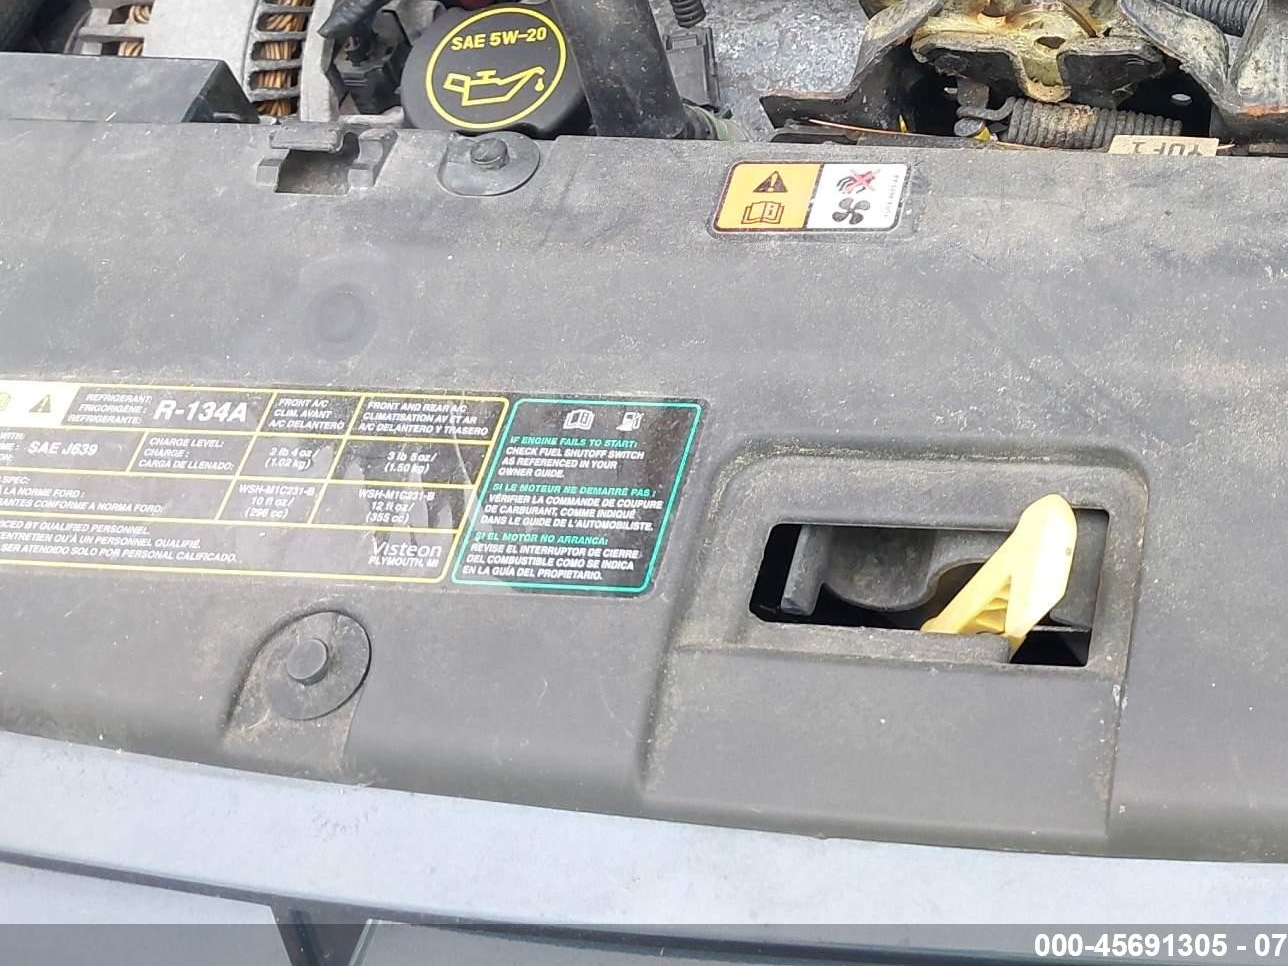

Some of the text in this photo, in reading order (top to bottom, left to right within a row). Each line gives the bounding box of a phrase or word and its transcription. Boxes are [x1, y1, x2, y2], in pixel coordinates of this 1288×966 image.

[451, 27, 548, 50] SAE 5W-20
[86, 393, 153, 404] REFRIGERANT:
[278, 398, 328, 408] FRONT A/C
[78, 402, 143, 413] FRIGORIGÈNE
[153, 400, 248, 422] R-134A
[274, 408, 332, 418] CLIM. AVANT
[368, 402, 468, 412] FRONT AND REAR A/C
[68, 414, 142, 424] REFRIGERANTE:
[362, 412, 478, 424] CLIMATISATION AV ET AR
[268, 419, 344, 430] A/C DELANTERO
[358, 422, 488, 435] A/C DELANTERO Y TRASERO
[149, 438, 224, 448] CHARGE LEVEL:
[510, 436, 638, 448] IF ENGINE FAILS TO START:
[28, 441, 61, 454] SAE
[62, 442, 98, 456] J639
[144, 448, 185, 458] CHARGE
[506, 447, 645, 460] CHECK FUEL SHUTOFF SWITCH
[387, 452, 438, 462] 3 lb 5 oz/
[138, 459, 234, 470] CARGA DE LLENADO:
[264, 458, 311, 470] (1.02 kg)
[384, 462, 430, 474] (1.50 kg)
[502, 458, 618, 469] AS REFERENCED IN YOUR
[498, 468, 565, 478] OWNER GUIDE.
[2, 476, 31, 484] SPEC:
[3, 486, 80, 498] LA NORME FORD
[358, 488, 436, 501] WSH-M1C231-B
[492, 483, 503, 491] SI
[505, 484, 518, 492] LE
[519, 484, 561, 493] MOTEUR
[563, 486, 578, 494] NE
[630, 488, 650, 497] PAS
[34, 499, 88, 509] CONFORME
[87, 502, 96, 510] A
[97, 502, 132, 512] NORMA
[133, 504, 164, 513] FORD:
[371, 501, 414, 512] 12 fl oz/
[489, 493, 664, 509] VÉRIFIER LA COMMANDE DE COUPURE
[270, 508, 288, 519] cc)
[484, 504, 636, 519] DE CARBURANT, COMME INDIQUÉ
[366, 512, 410, 524] (355 cc)
[480, 515, 654, 531] DANS LE GUIDE DE L'AUTOMOBILISTE.
[24, 521, 150, 535] BY QUALIFIED PERSONNEL.
[54, 532, 78, 543] QU'À
[80, 534, 94, 544] UN
[95, 536, 153, 547] PERSONNEL
[154, 538, 200, 549] QUALIFIÉ.
[475, 532, 608, 546] SI EL MOTOR NO ARRANCA:
[0, 543, 237, 562] SER ATENDIDO SOLO POR PERSONAL CALIFICADO.
[371, 538, 442, 557] Visteon
[470, 543, 639, 559] REVISE EL INTERRUPTOR DE CIERRE
[368, 556, 440, 568] PLYMOUTH, MI
[466, 555, 634, 570] DEL COMBUSTIBLE COMO SE INDICA
[462, 566, 602, 580] EN LA GUÍA DEL PROPIETARIO.
